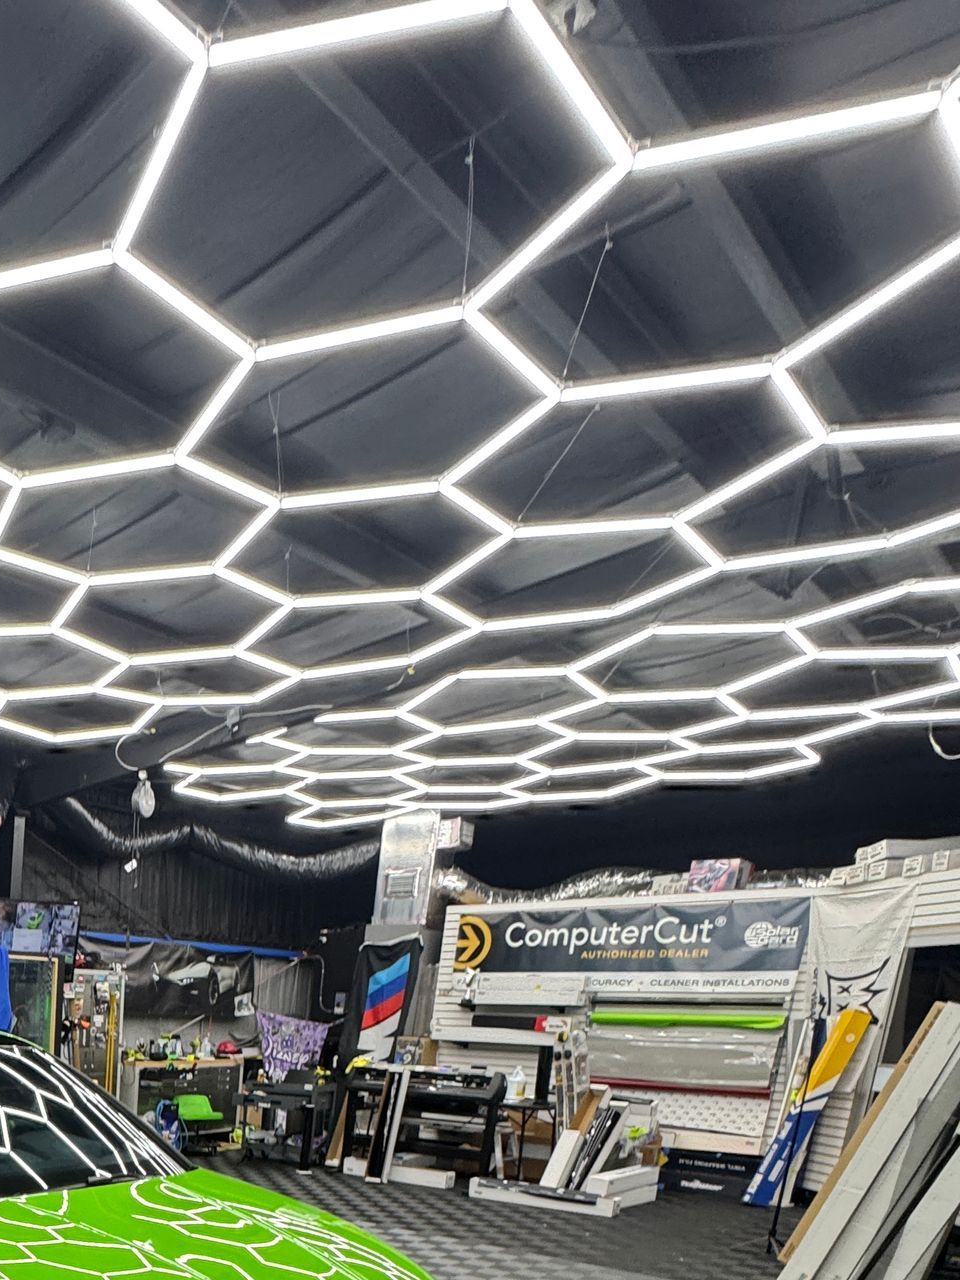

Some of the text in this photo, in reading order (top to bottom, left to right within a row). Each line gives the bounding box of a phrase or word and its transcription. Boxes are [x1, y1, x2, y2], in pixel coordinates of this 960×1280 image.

[580, 947, 709, 960] AUTHORIZED DEALER
[591, 978, 790, 987] CURACY CLEANER INSTALLATIONS
